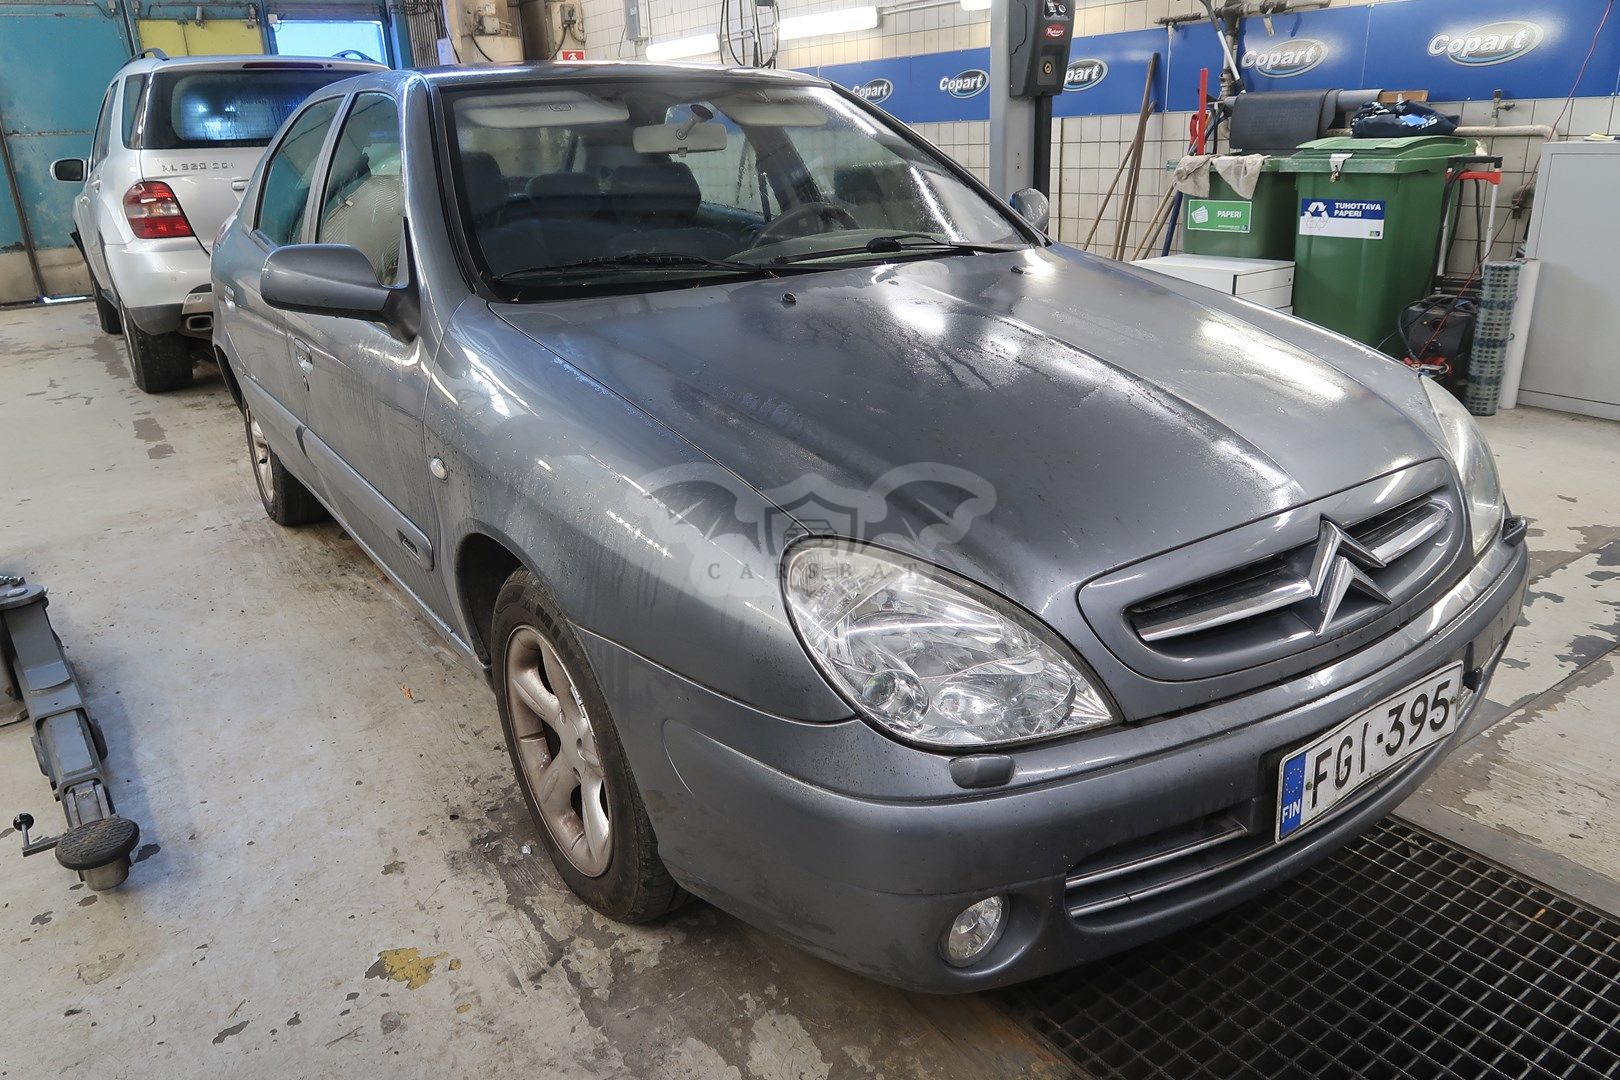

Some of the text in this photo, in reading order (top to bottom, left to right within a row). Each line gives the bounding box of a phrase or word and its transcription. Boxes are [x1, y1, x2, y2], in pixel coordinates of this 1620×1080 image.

[1427, 28, 1527, 57] Copart
[1241, 44, 1317, 70] Copart
[939, 73, 983, 92] Copart
[1064, 64, 1101, 85] part
[852, 82, 888, 99] Copart
[181, 162, 207, 171] 320
[1217, 210, 1242, 218] PAPERI
[1334, 202, 1382, 211] TUHOTTAVA
[1311, 680, 1452, 809] FGI-395
[1282, 798, 1301, 824] FIN
